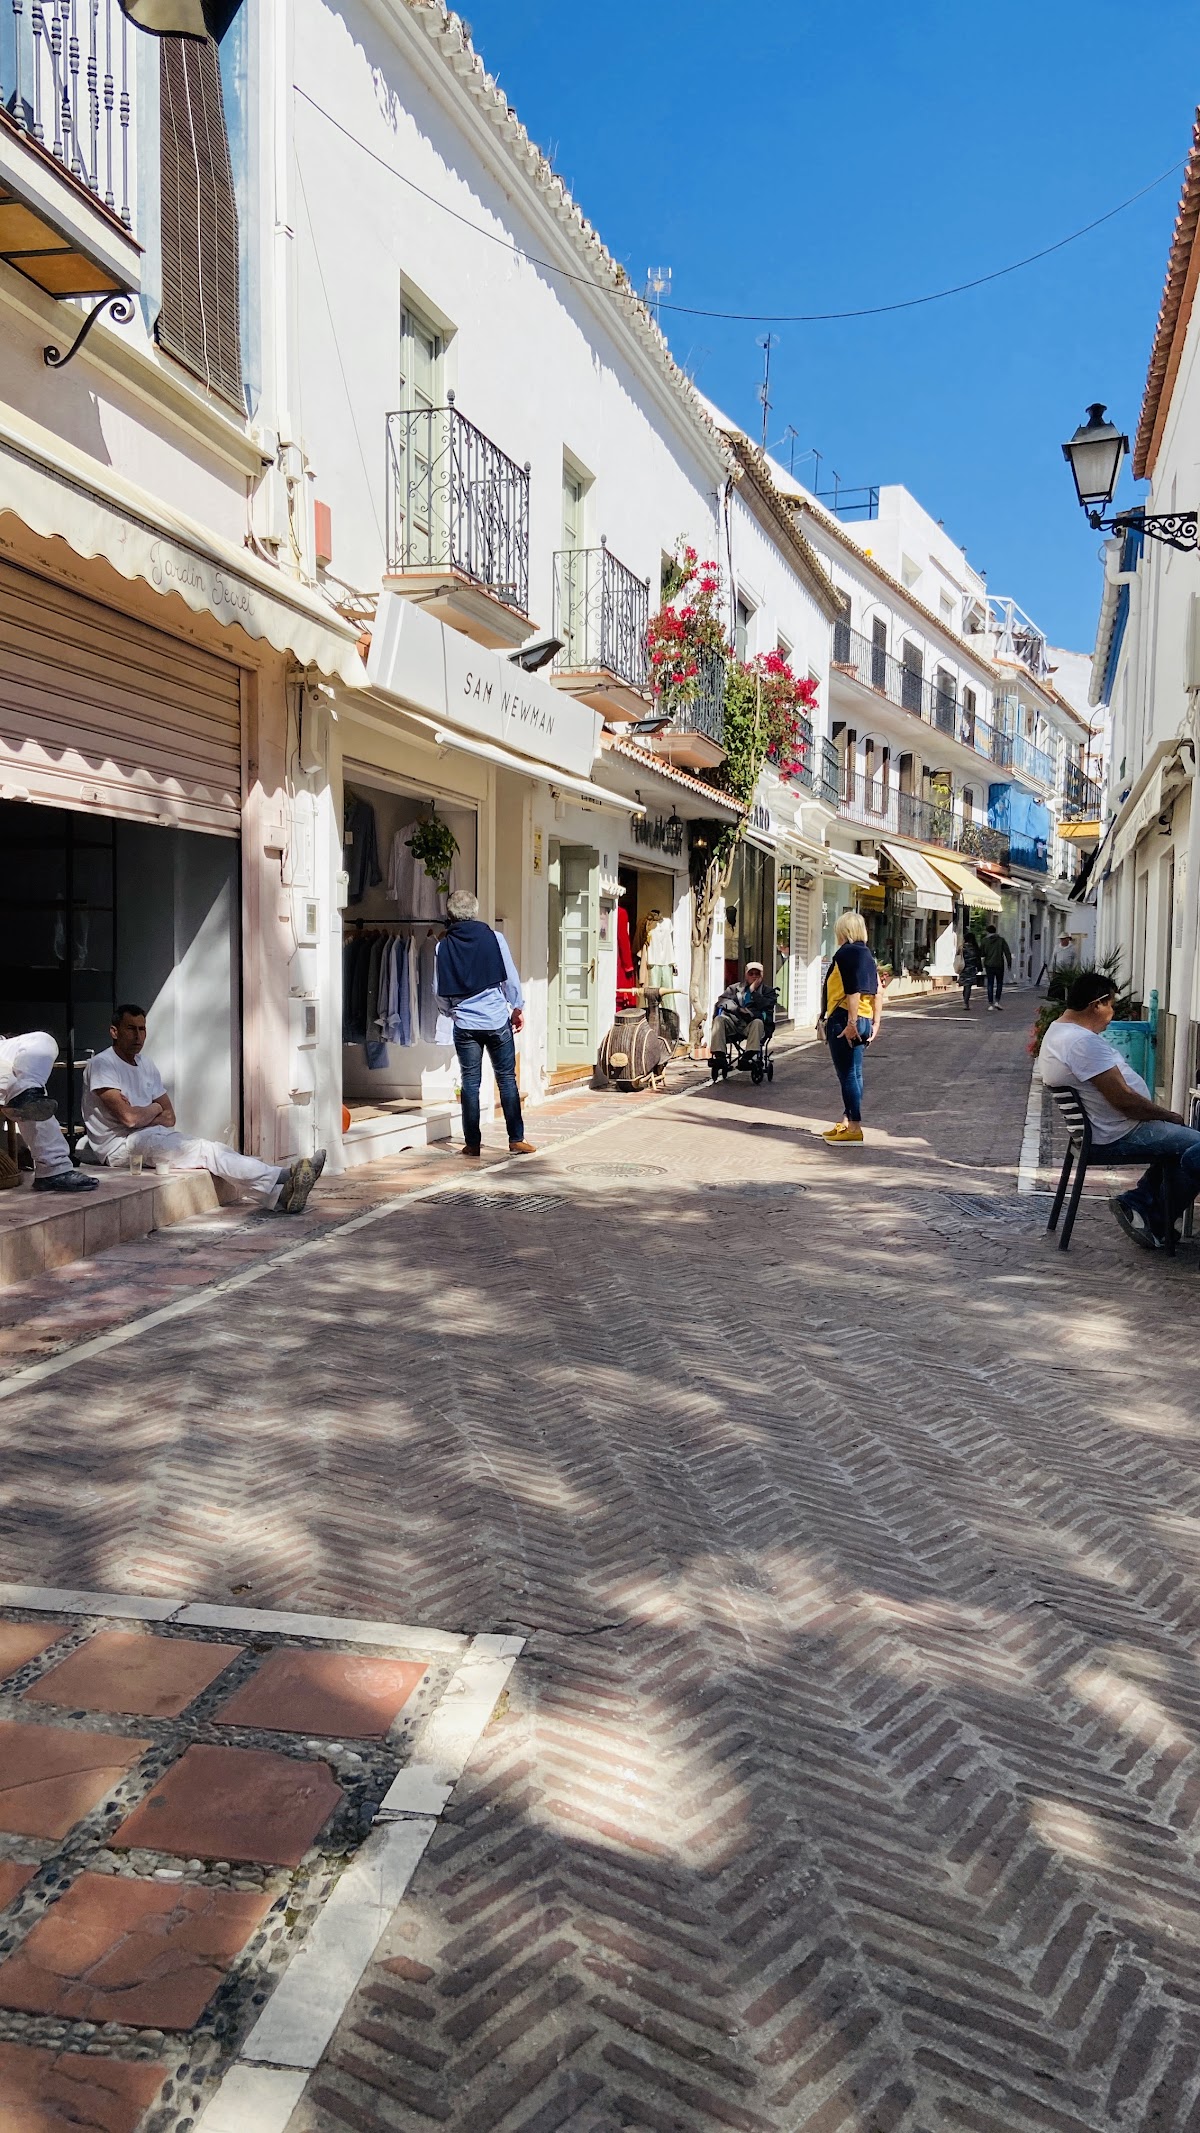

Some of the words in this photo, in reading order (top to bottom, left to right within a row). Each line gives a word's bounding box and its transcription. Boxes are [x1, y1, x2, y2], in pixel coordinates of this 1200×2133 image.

[150, 540, 205, 592] Jardin
[212, 572, 255, 616] Secret
[463, 672, 493, 705] SAM
[501, 691, 555, 736] NEWMAN
